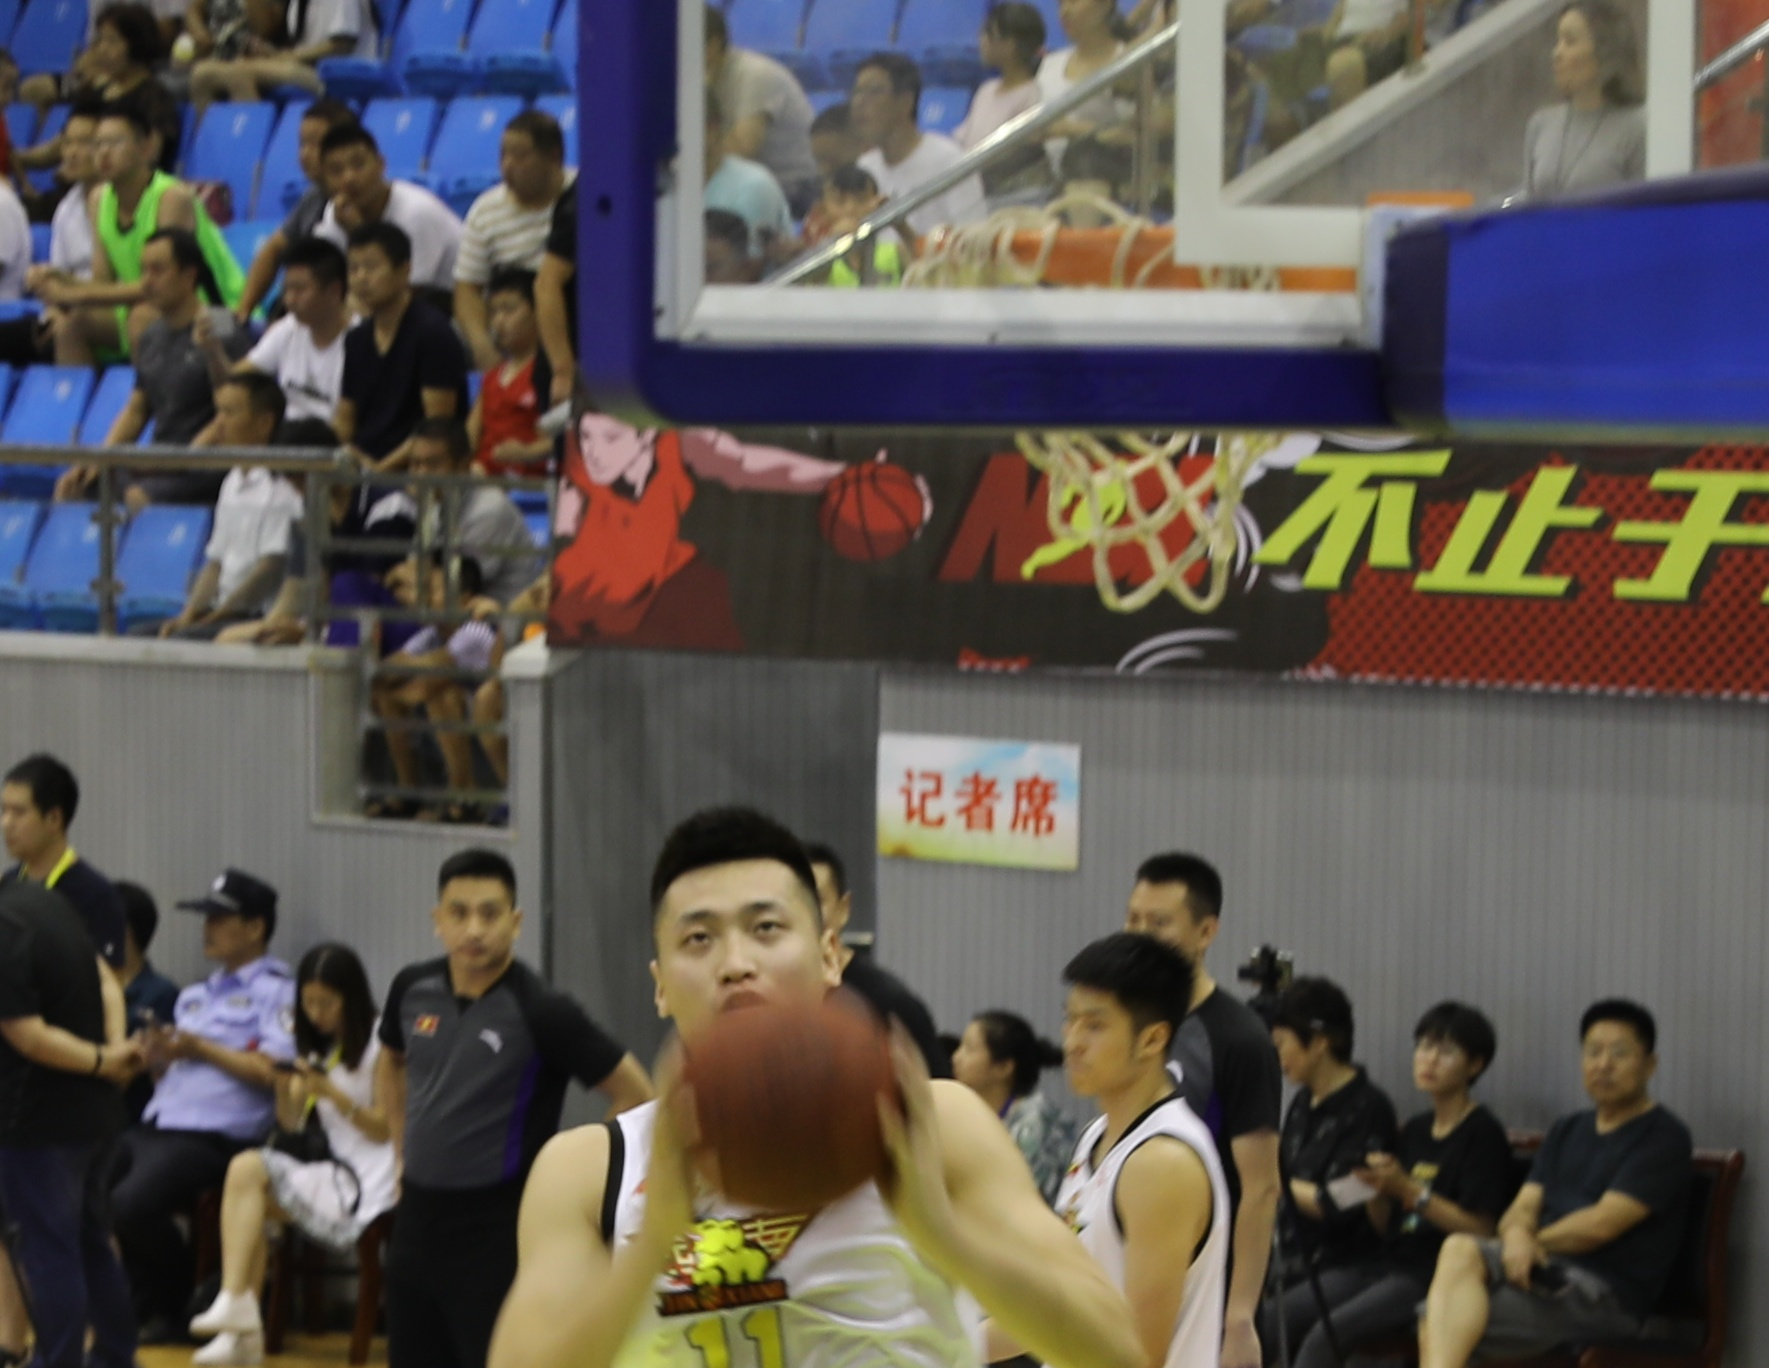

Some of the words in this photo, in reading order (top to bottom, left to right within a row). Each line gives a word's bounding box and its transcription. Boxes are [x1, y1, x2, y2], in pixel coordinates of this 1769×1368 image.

[1251, 449, 1769, 604] 不止于
[899, 768, 1058, 837] 记者席
